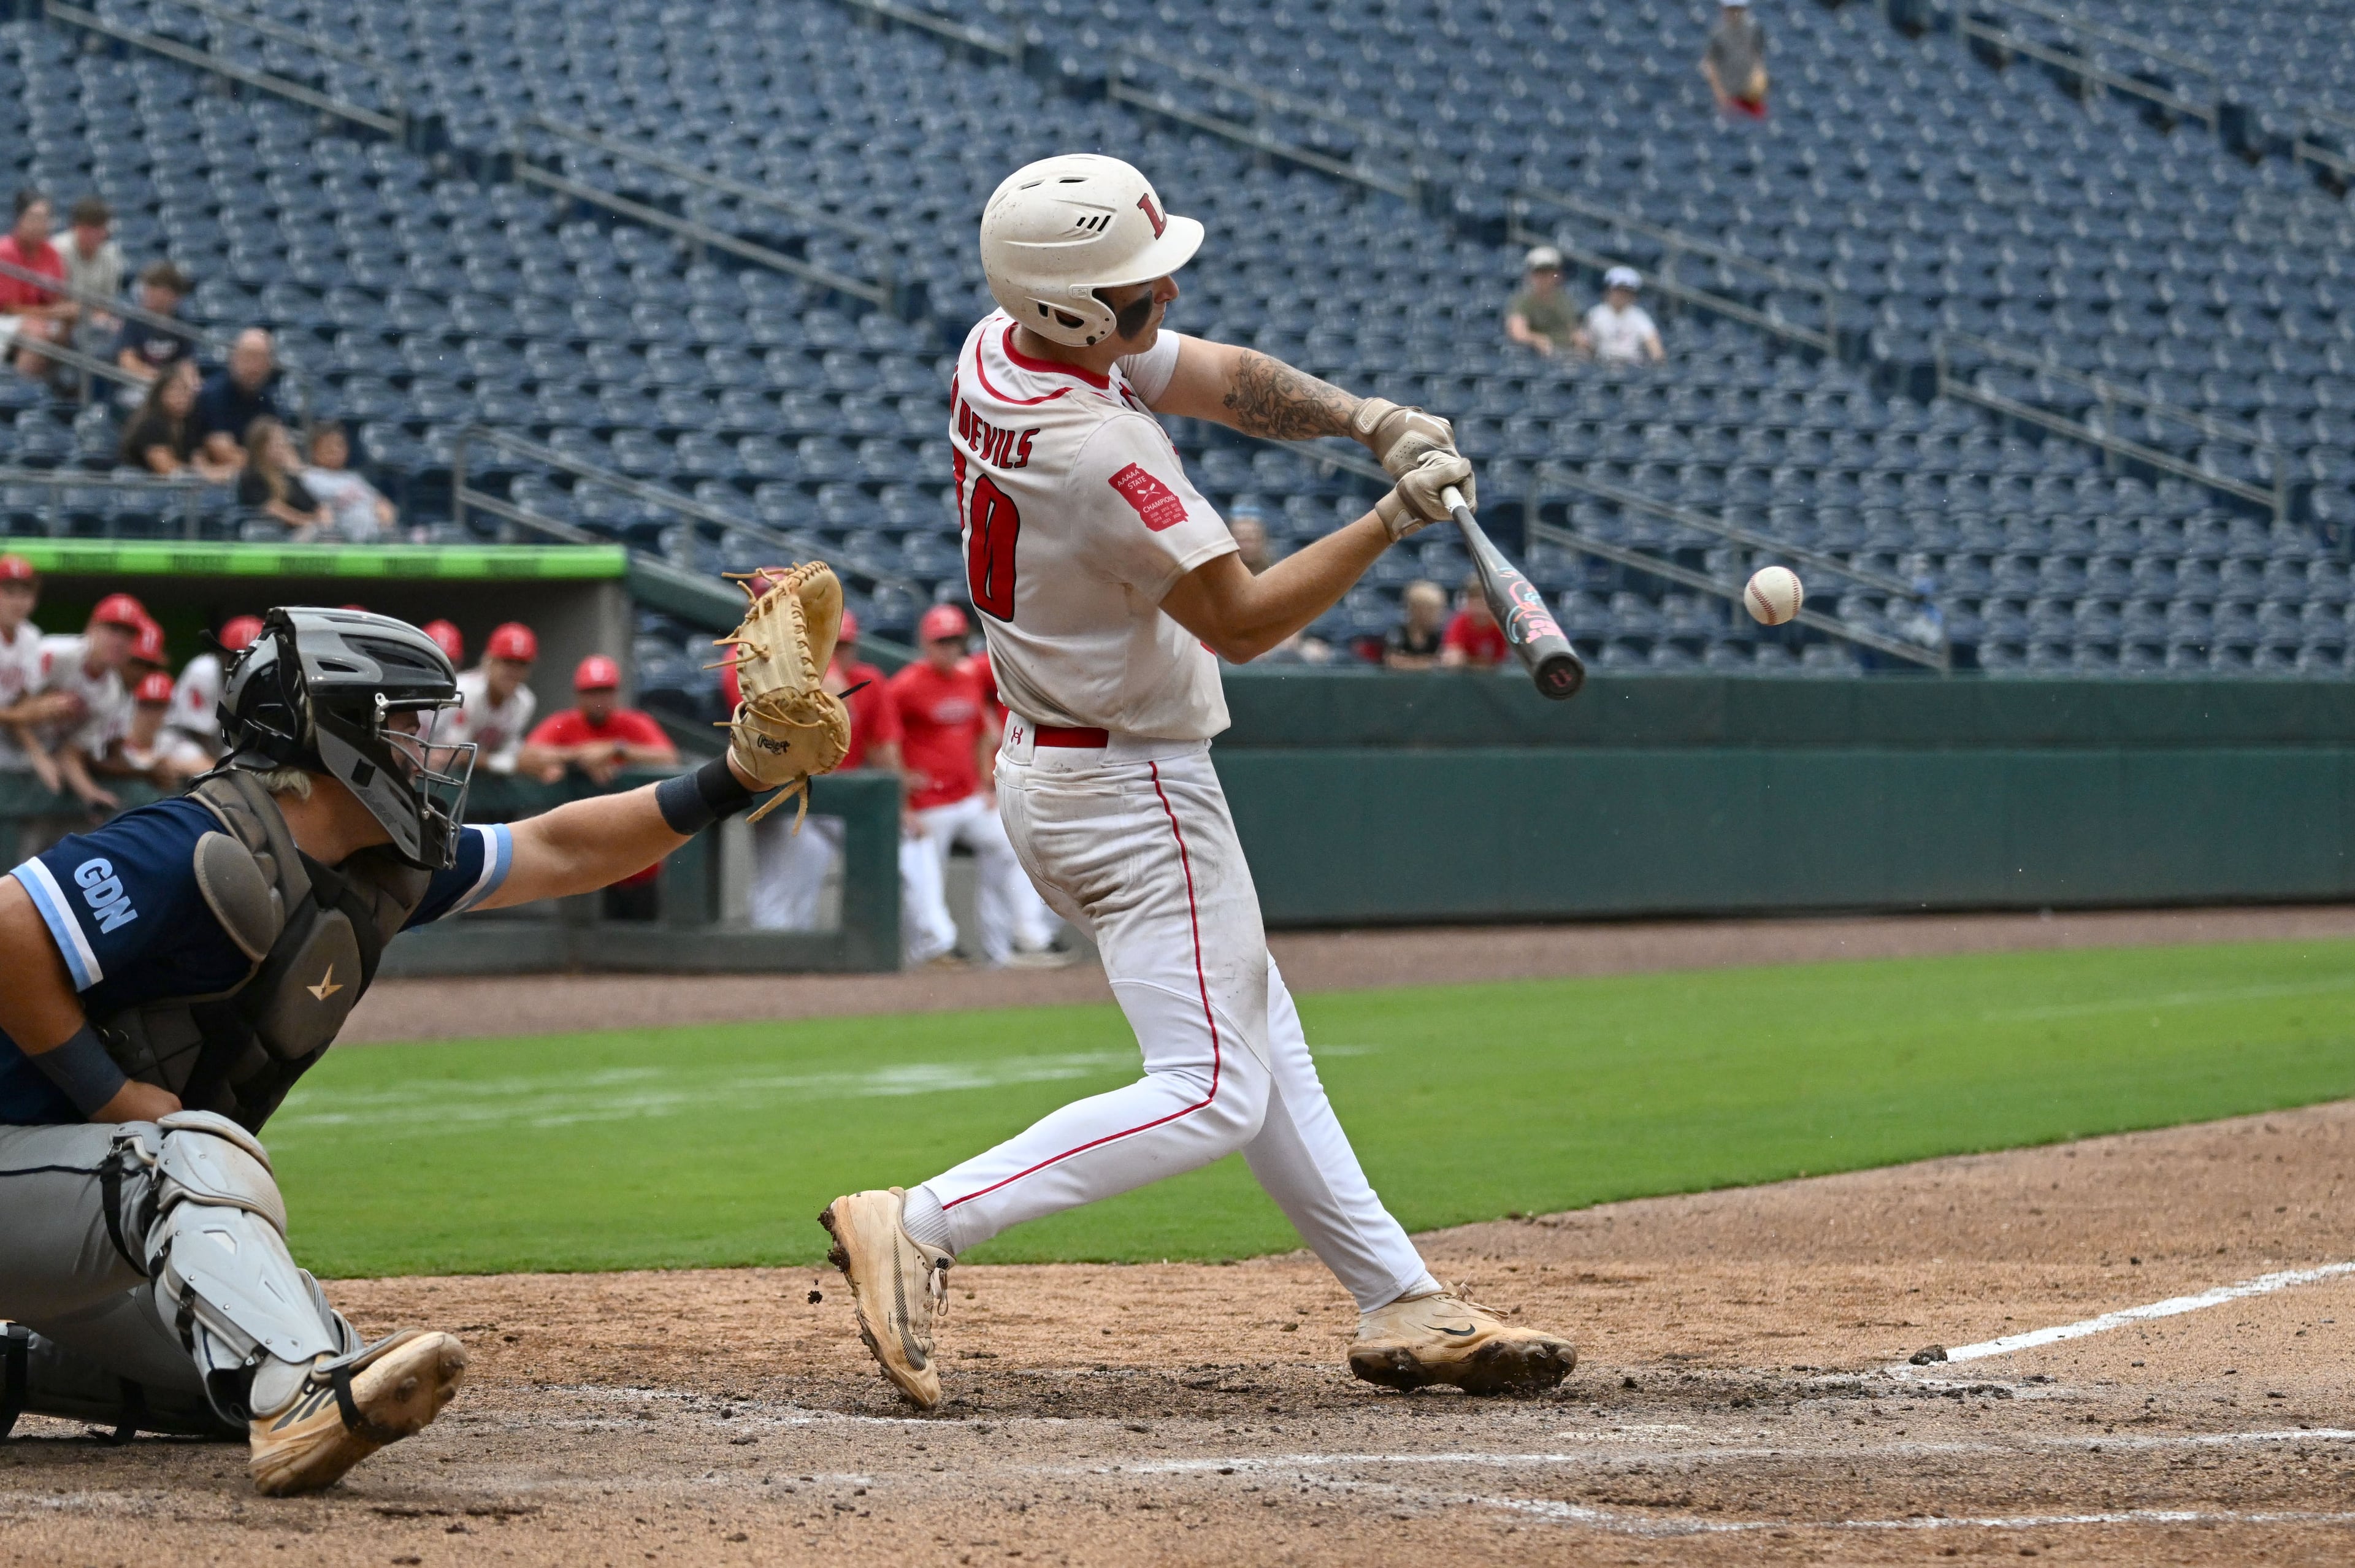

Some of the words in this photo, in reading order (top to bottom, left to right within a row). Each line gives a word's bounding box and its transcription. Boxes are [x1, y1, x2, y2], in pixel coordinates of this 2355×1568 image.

[1136, 193, 1167, 240] L
[959, 397, 1040, 468] DEVILS
[1117, 469, 1140, 487] AAAAA
[1128, 476, 1147, 489] STATE
[1143, 494, 1176, 513] CHAMPIONS
[74, 858, 138, 934] GDN
